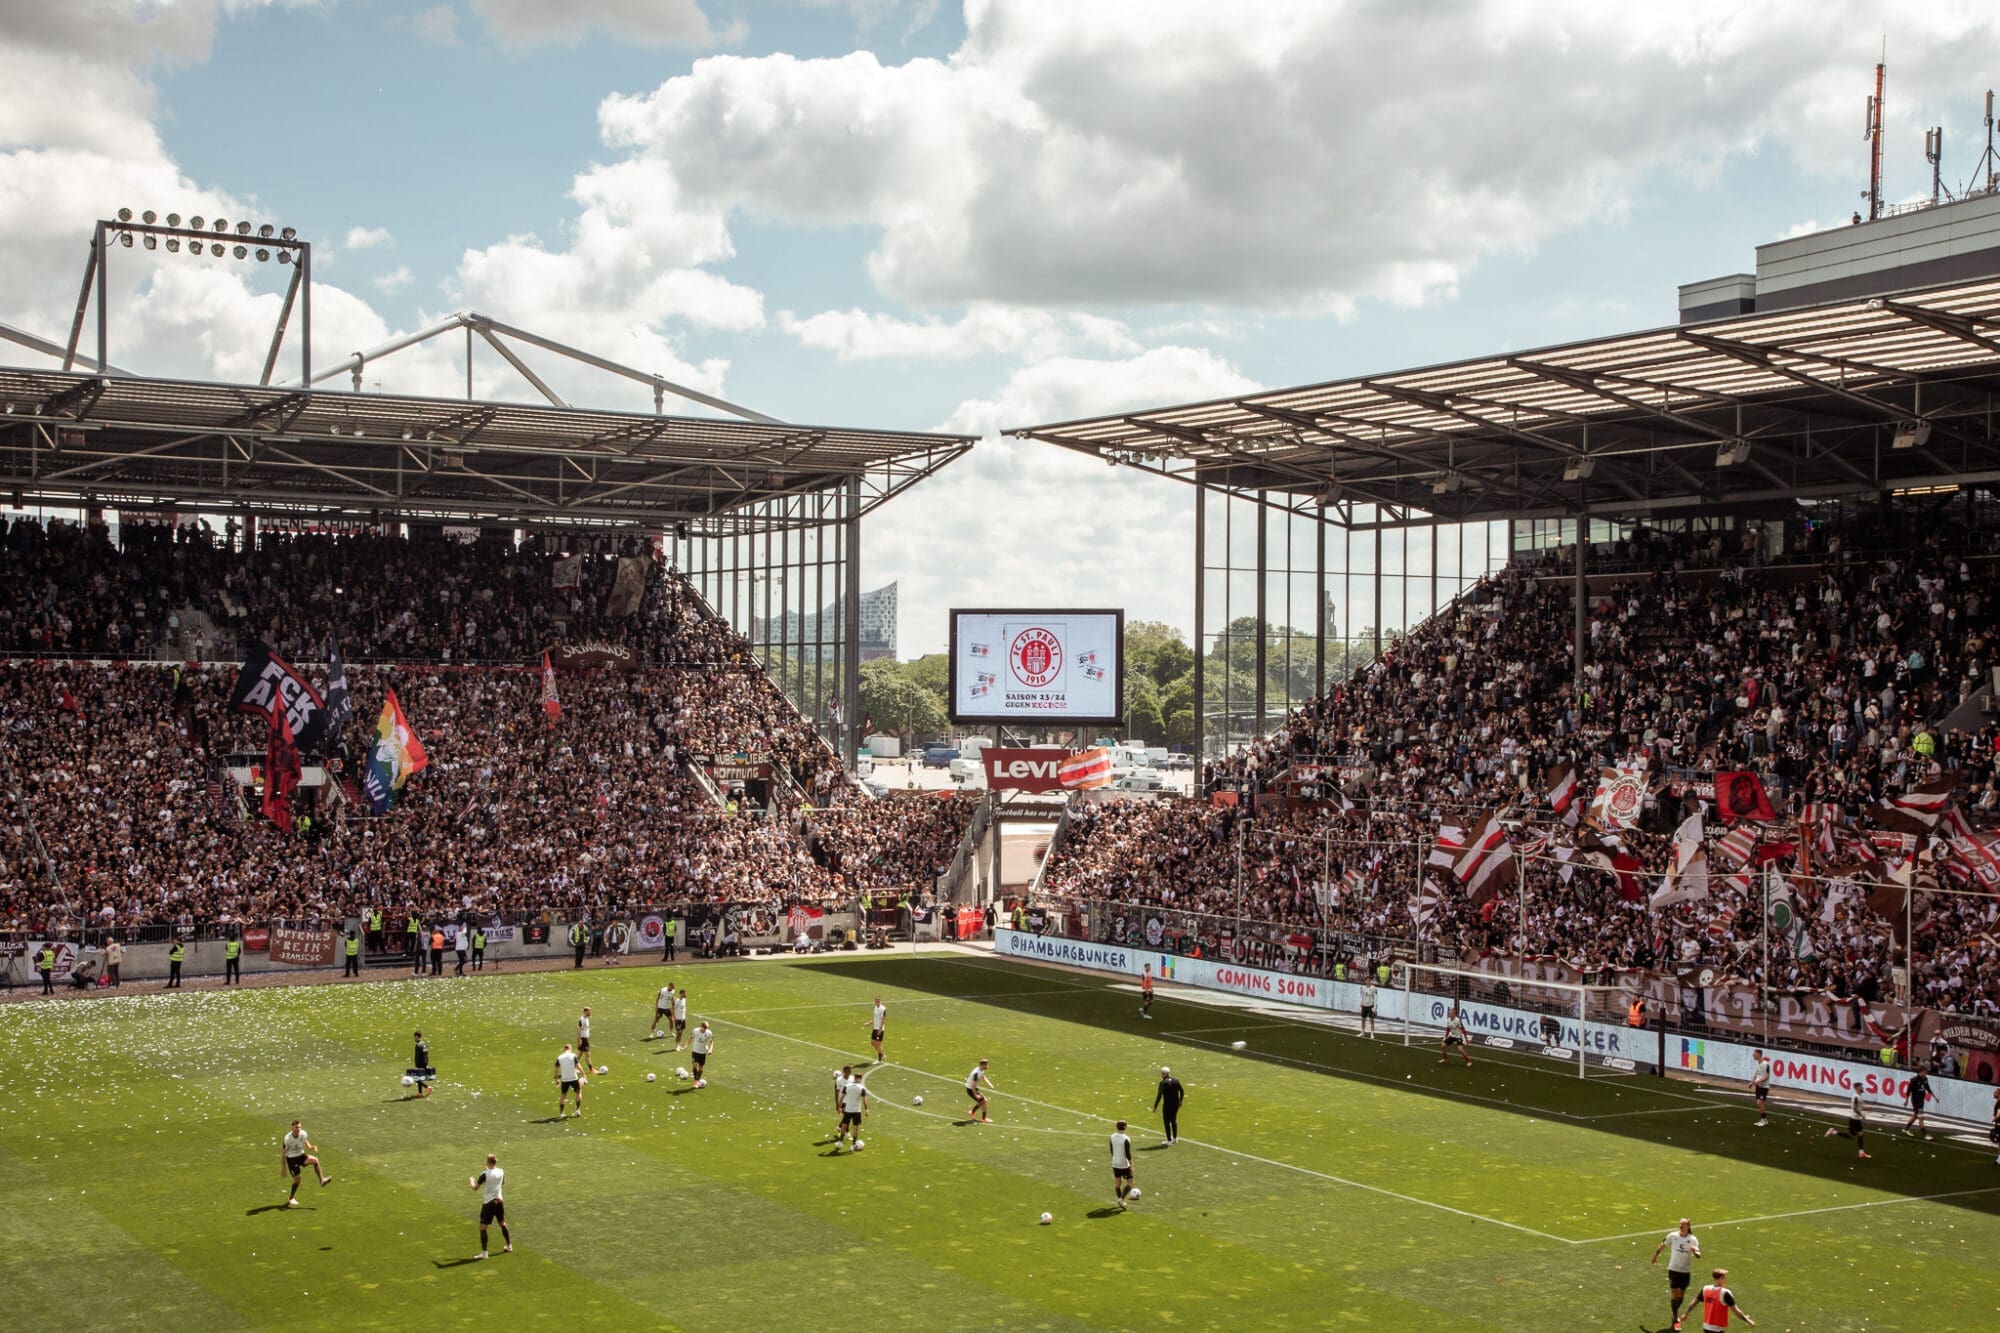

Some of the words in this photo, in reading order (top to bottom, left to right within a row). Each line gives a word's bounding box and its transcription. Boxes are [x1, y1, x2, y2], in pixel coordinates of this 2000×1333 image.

[1013, 644, 1022, 656] FC
[1036, 631, 1059, 656] PAULI
[1026, 674, 1046, 684] 1910
[1005, 693, 1037, 701] SAISON
[1010, 935, 1127, 968] @HAMBURGBUNKER
[1216, 968, 1271, 992] COMING
[1278, 979, 1316, 998] SOON
[1431, 1001, 1620, 1052] @AMBURGUNKER
[1865, 1074, 1932, 1103] SOO
